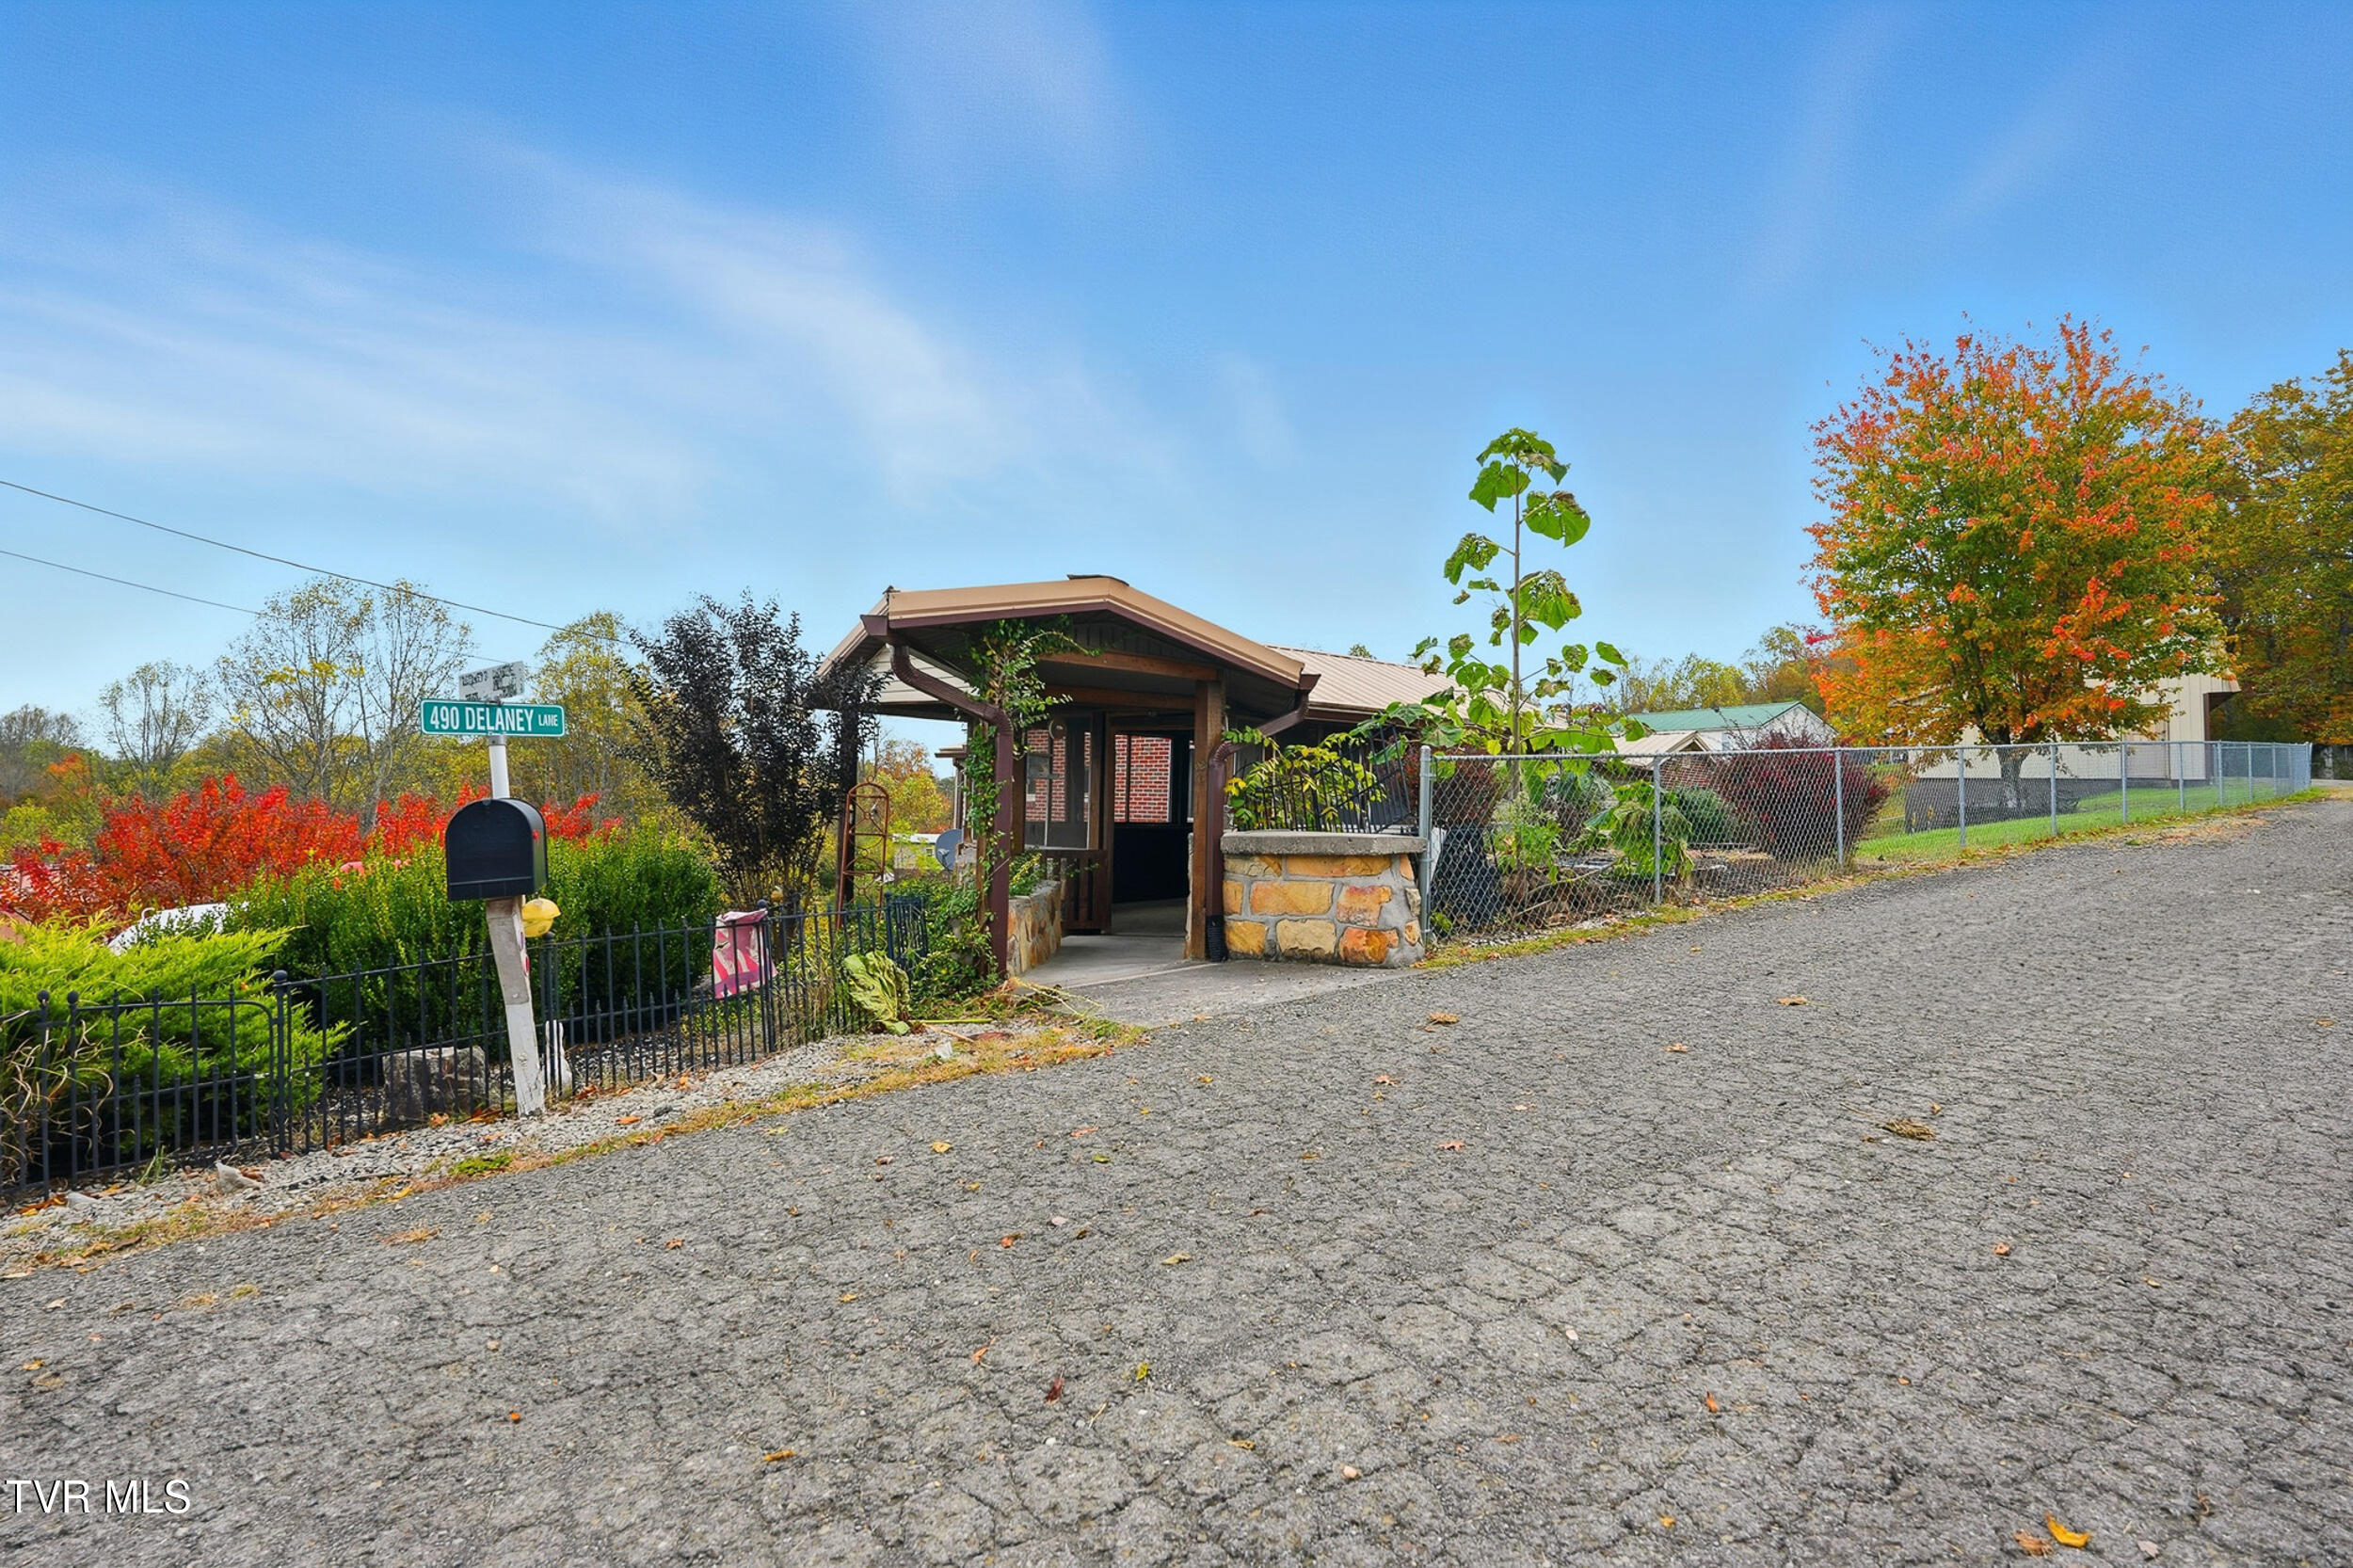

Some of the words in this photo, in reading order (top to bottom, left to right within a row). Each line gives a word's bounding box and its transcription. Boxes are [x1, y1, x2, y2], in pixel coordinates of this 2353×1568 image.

[430, 706, 459, 730] 490
[465, 707, 535, 732] DELANEY
[537, 713, 559, 728] LANE
